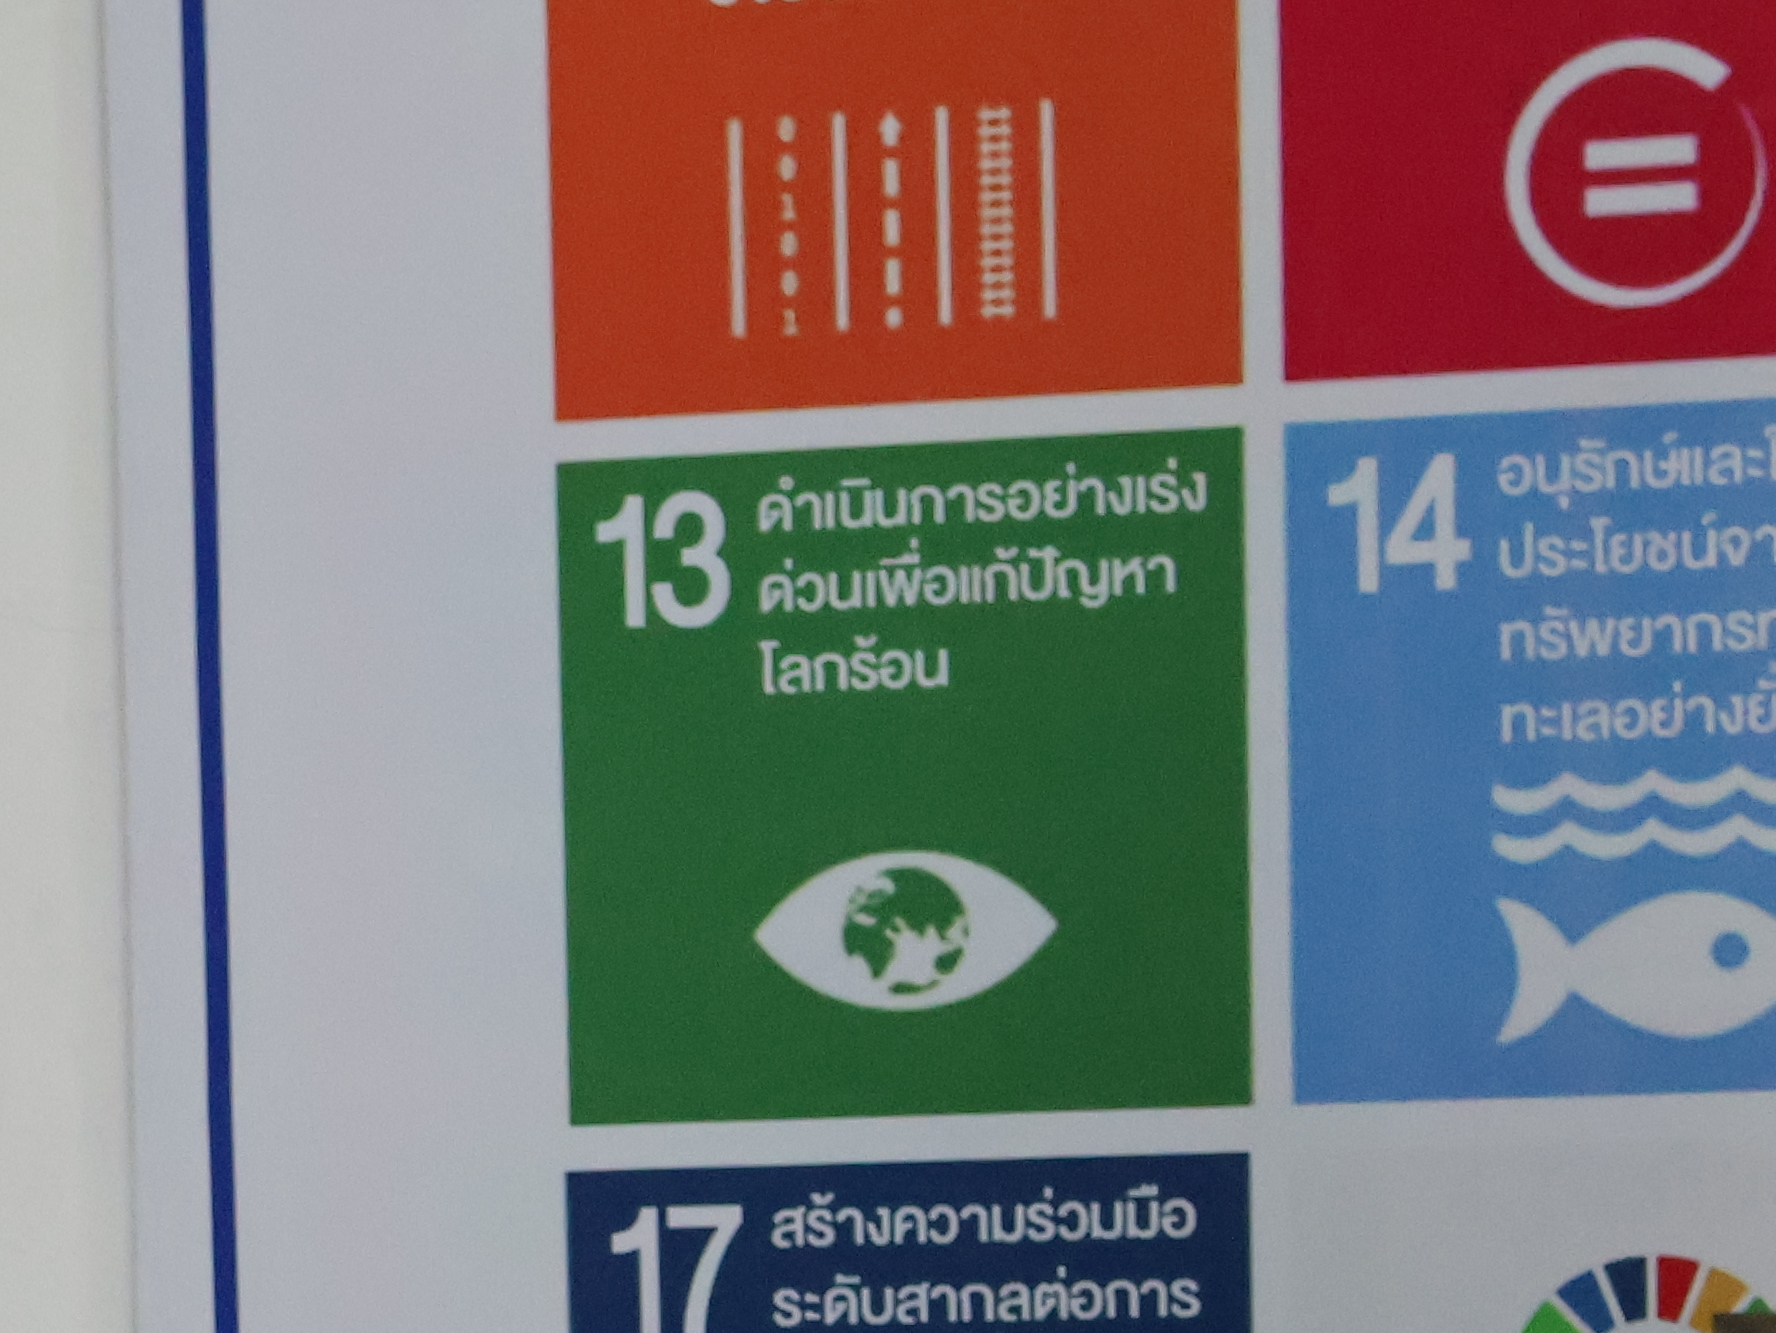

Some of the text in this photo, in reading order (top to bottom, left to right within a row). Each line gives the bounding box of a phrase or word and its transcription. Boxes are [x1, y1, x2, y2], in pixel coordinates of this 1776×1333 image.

[757, 457, 1208, 533] ดำเนินการอย่างเร่ง
[1327, 452, 1472, 593] 14
[595, 489, 731, 629] 13
[758, 537, 1177, 613] ด่วนเพื่อแก้ปัญหา
[757, 634, 949, 696] โลกร้อน
[770, 1185, 1197, 1249] สร้างความร่วมมือ
[773, 1266, 1202, 1328] ระดับสากลต่อการ
